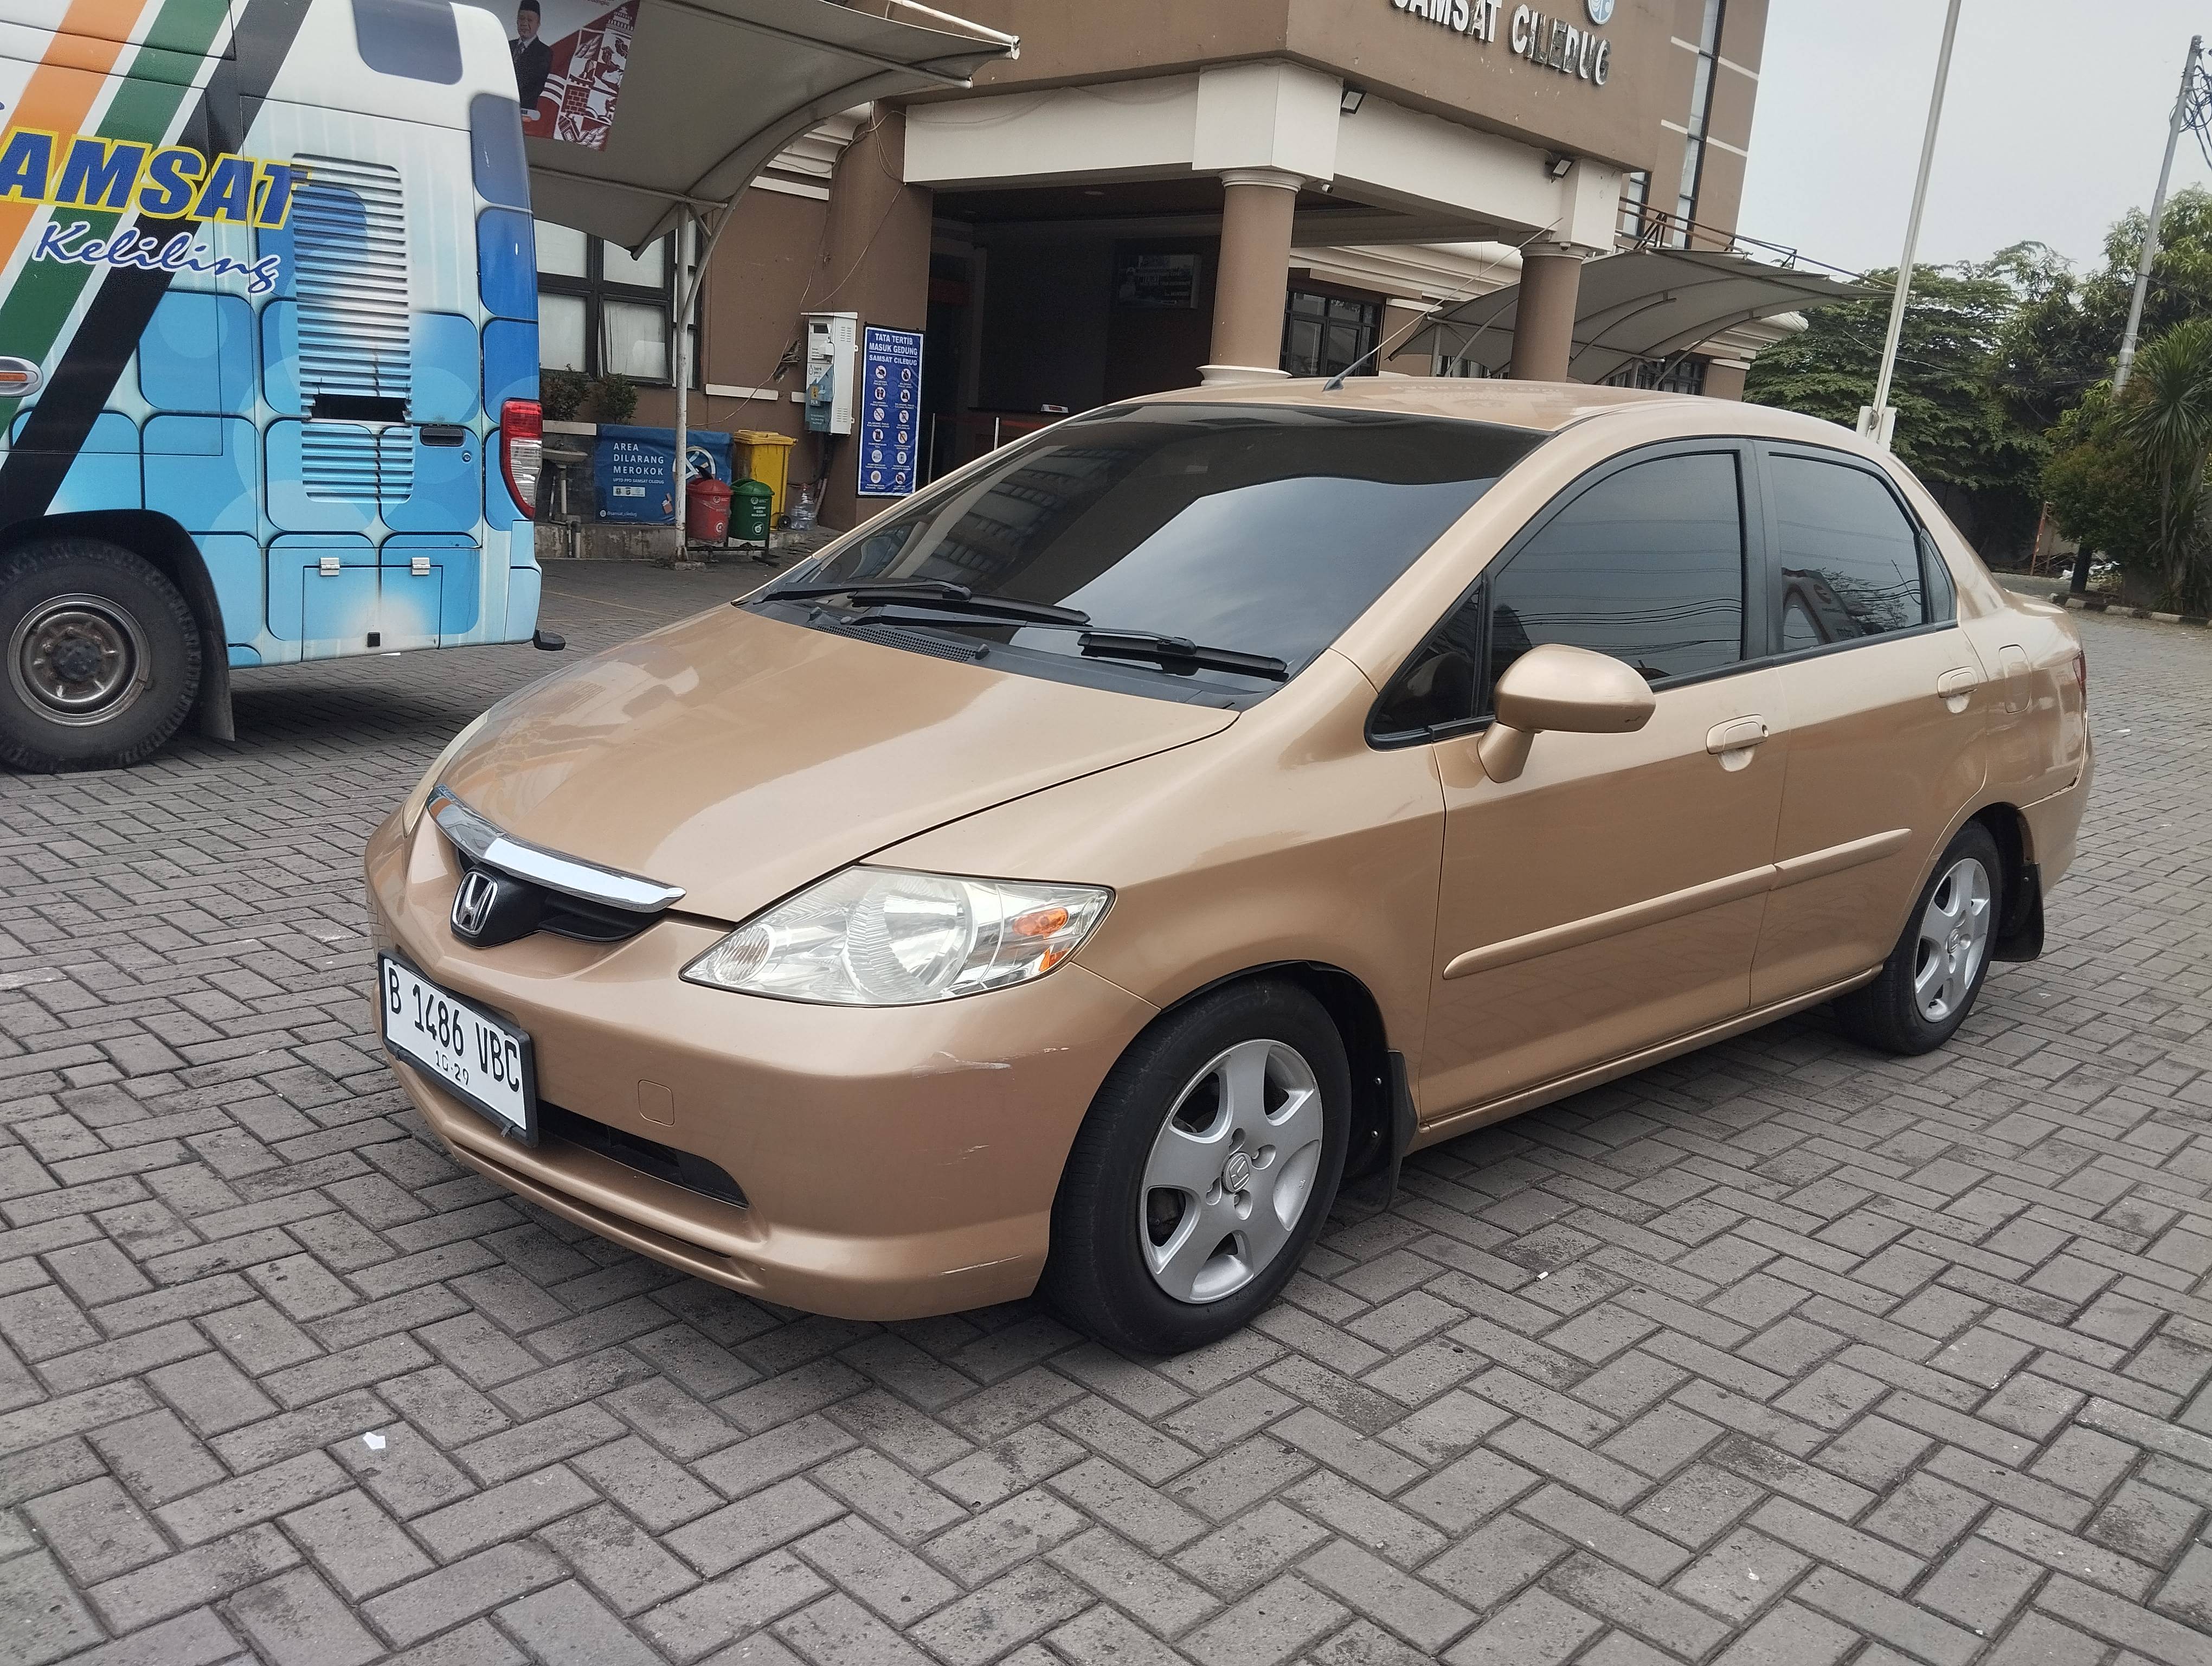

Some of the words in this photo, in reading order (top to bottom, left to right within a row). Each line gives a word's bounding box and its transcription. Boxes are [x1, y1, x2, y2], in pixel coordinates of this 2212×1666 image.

[1393, 0, 1502, 42] SAT
[1512, 4, 1611, 85] CILEDUG
[32, 221, 280, 295] Keliling
[875, 333, 891, 343] TATA
[891, 335, 913, 345] TERTIB
[869, 342, 893, 353] MASUK
[893, 345, 918, 356] GEDUNG
[869, 355, 892, 363] SAMSAT
[893, 357, 917, 366] CILEDUG
[613, 443, 639, 451] AREA
[613, 454, 664, 464] DILARANG
[613, 465, 663, 475] MEROKOK
[389, 966, 401, 1015] B
[413, 983, 464, 1056] 1486
[475, 1022, 519, 1092] VBC
